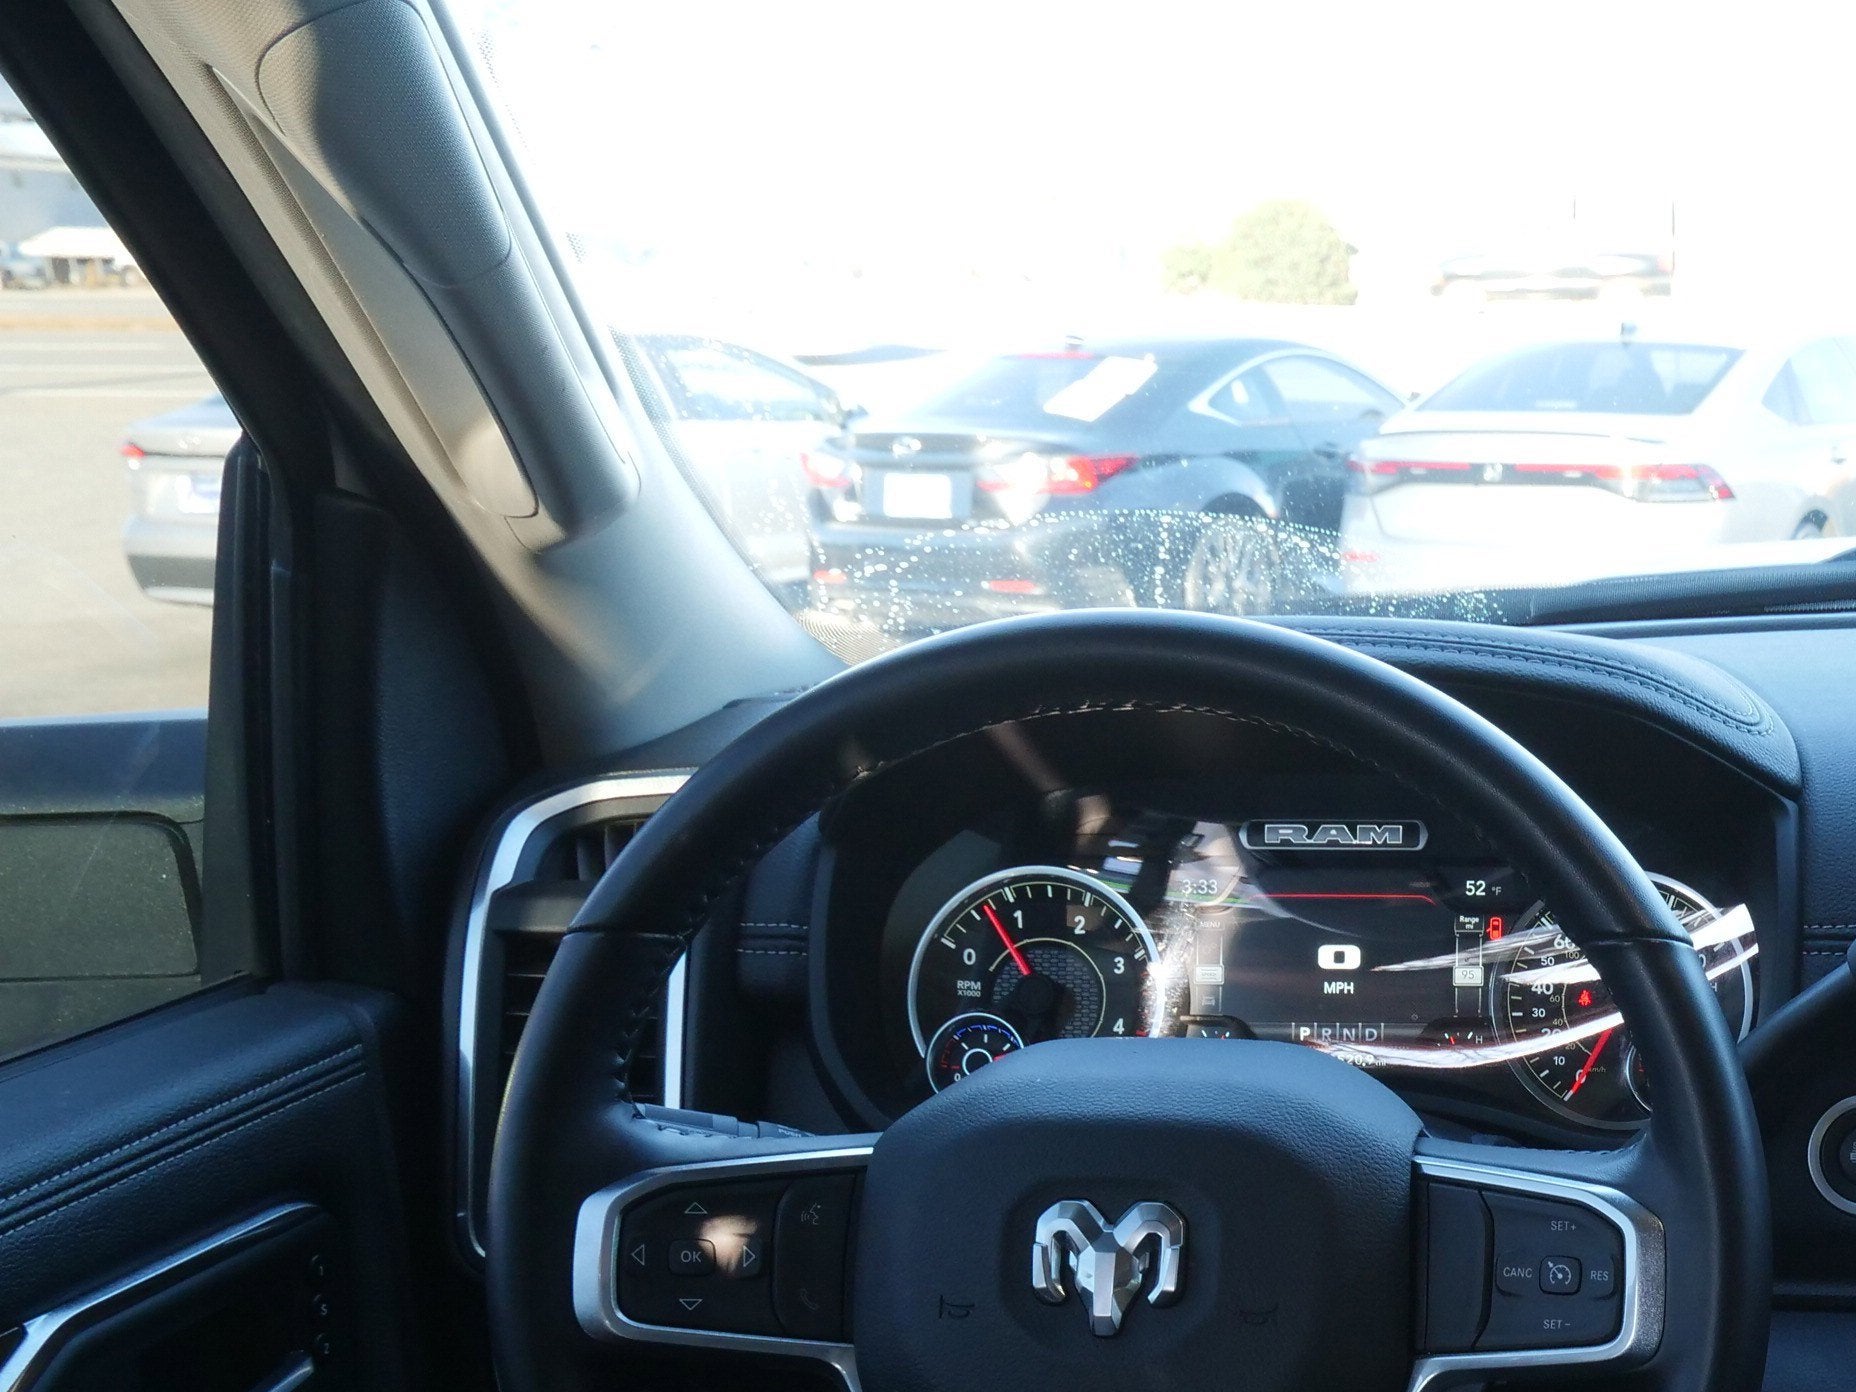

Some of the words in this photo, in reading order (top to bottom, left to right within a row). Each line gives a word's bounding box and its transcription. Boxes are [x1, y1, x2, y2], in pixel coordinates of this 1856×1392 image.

[1264, 824, 1402, 844] RAM
[1182, 879, 1218, 894] 3:33
[1466, 881, 1486, 896] 52
[1013, 909, 1023, 928] 1
[1073, 915, 1087, 935] 2
[1460, 916, 1480, 924] Range
[963, 948, 977, 966] 0
[1318, 944, 1361, 970] 0
[1540, 957, 1555, 967] 50
[1112, 956, 1125, 974] 3
[1461, 969, 1475, 980] 95
[956, 980, 981, 990] RPM
[1323, 983, 1355, 994] MPH
[1550, 995, 1561, 1003] 60
[1531, 1008, 1546, 1018] 30
[1112, 1017, 1125, 1035] 4
[1300, 1026, 1310, 1041] P
[1321, 1028, 1332, 1042] R
[1343, 1028, 1355, 1042] N
[1365, 1028, 1378, 1042] D
[1553, 1056, 1566, 1066] 10
[680, 1250, 701, 1263] OK
[1503, 1267, 1533, 1279] CANC
[1590, 1270, 1609, 1282] RES
